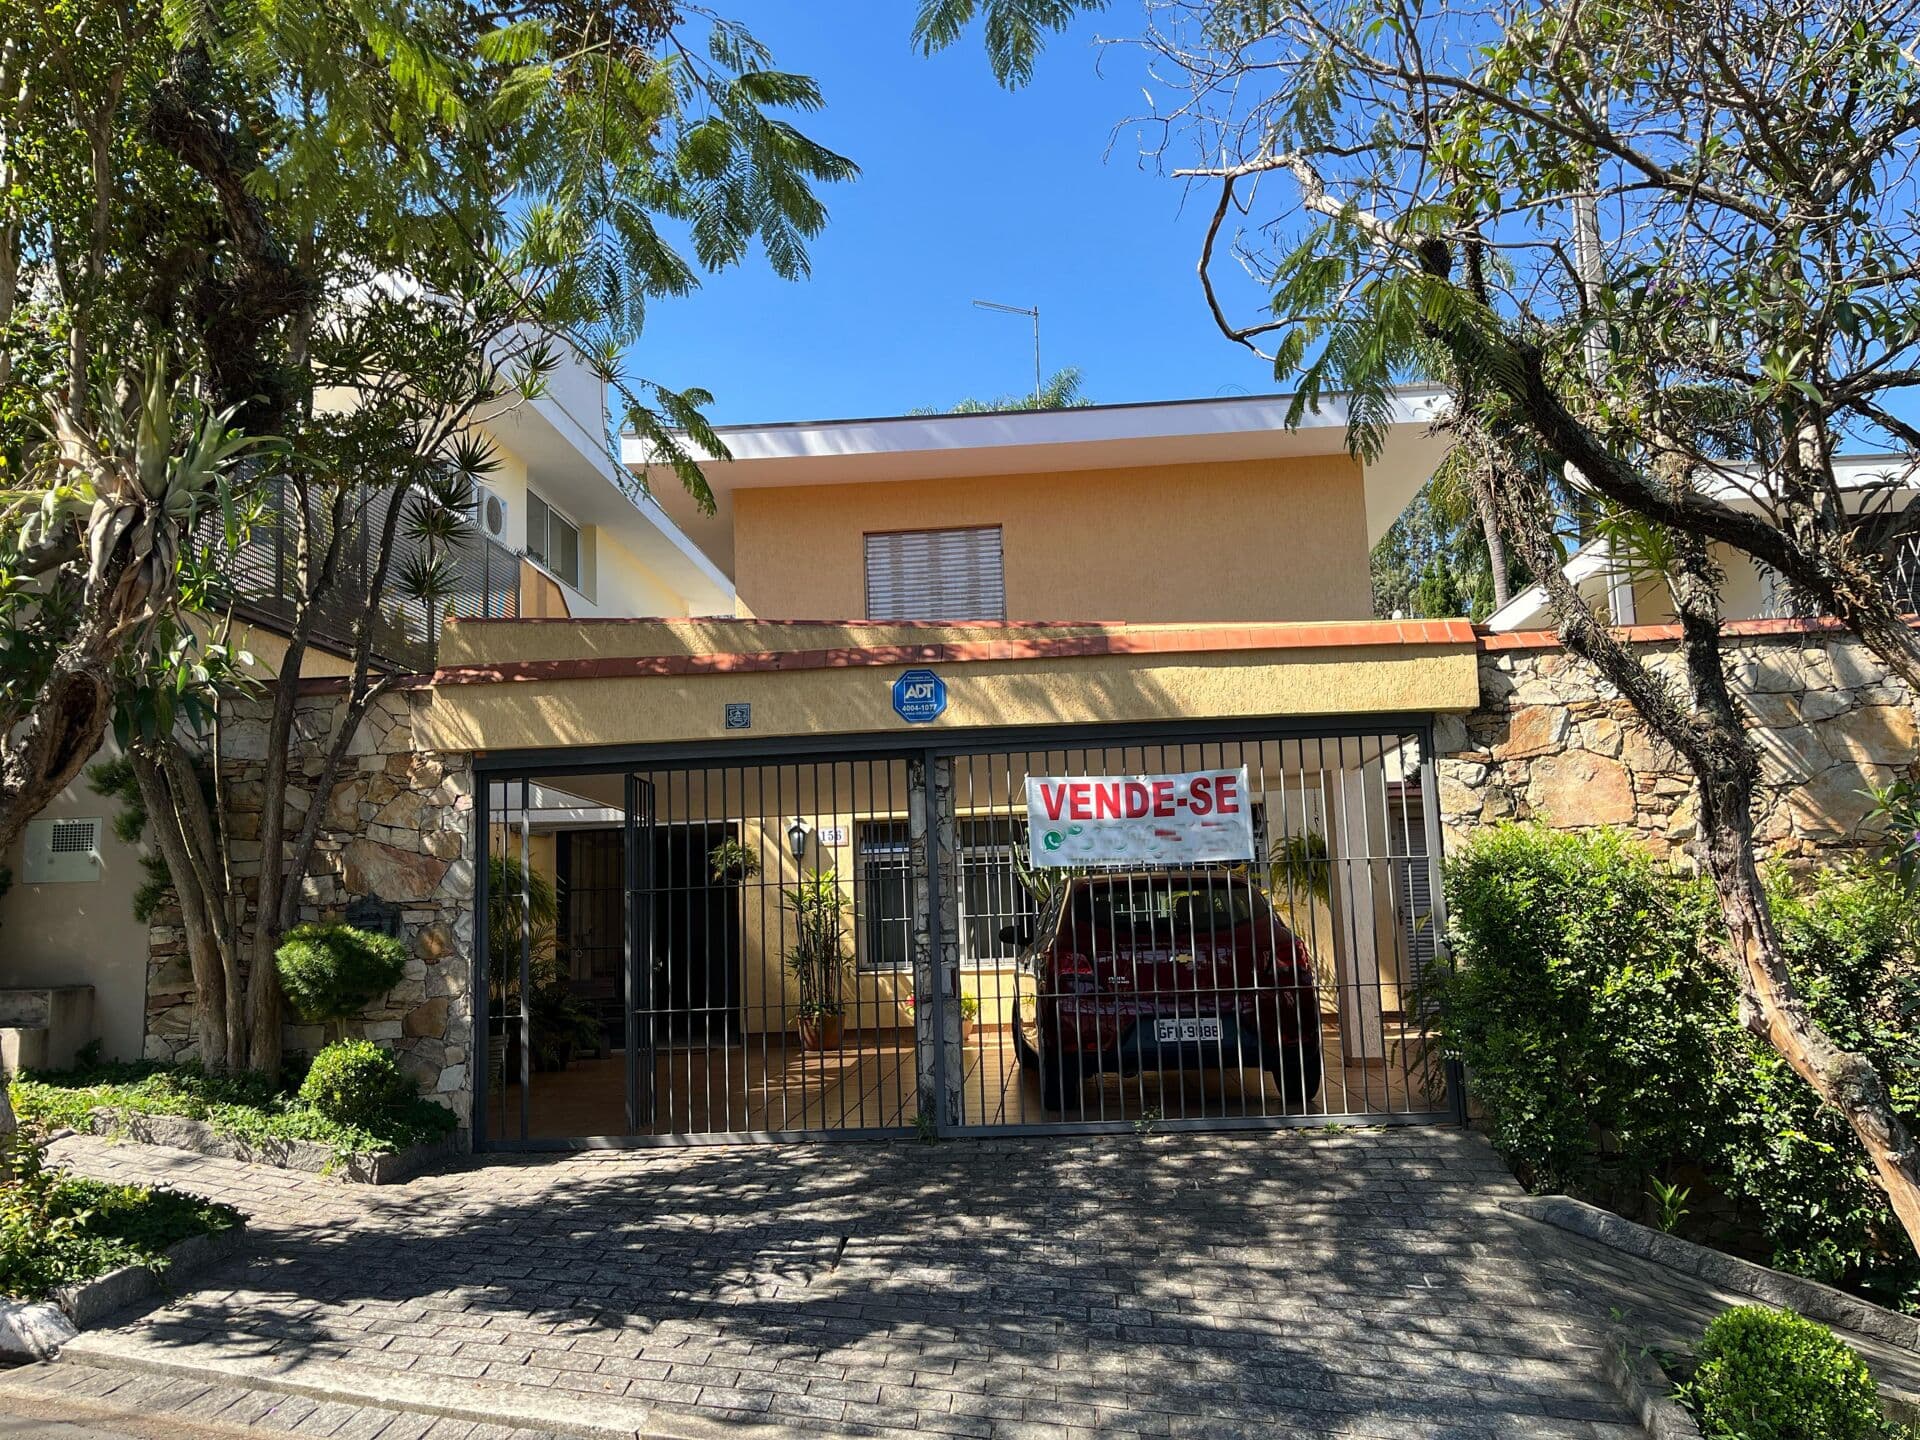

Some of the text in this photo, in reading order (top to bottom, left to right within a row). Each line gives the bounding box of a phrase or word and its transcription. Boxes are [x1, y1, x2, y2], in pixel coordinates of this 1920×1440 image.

[905, 683, 935, 699] ADT
[902, 703, 938, 712] 4004-1077
[1040, 776, 1239, 821] VENDE-SE
